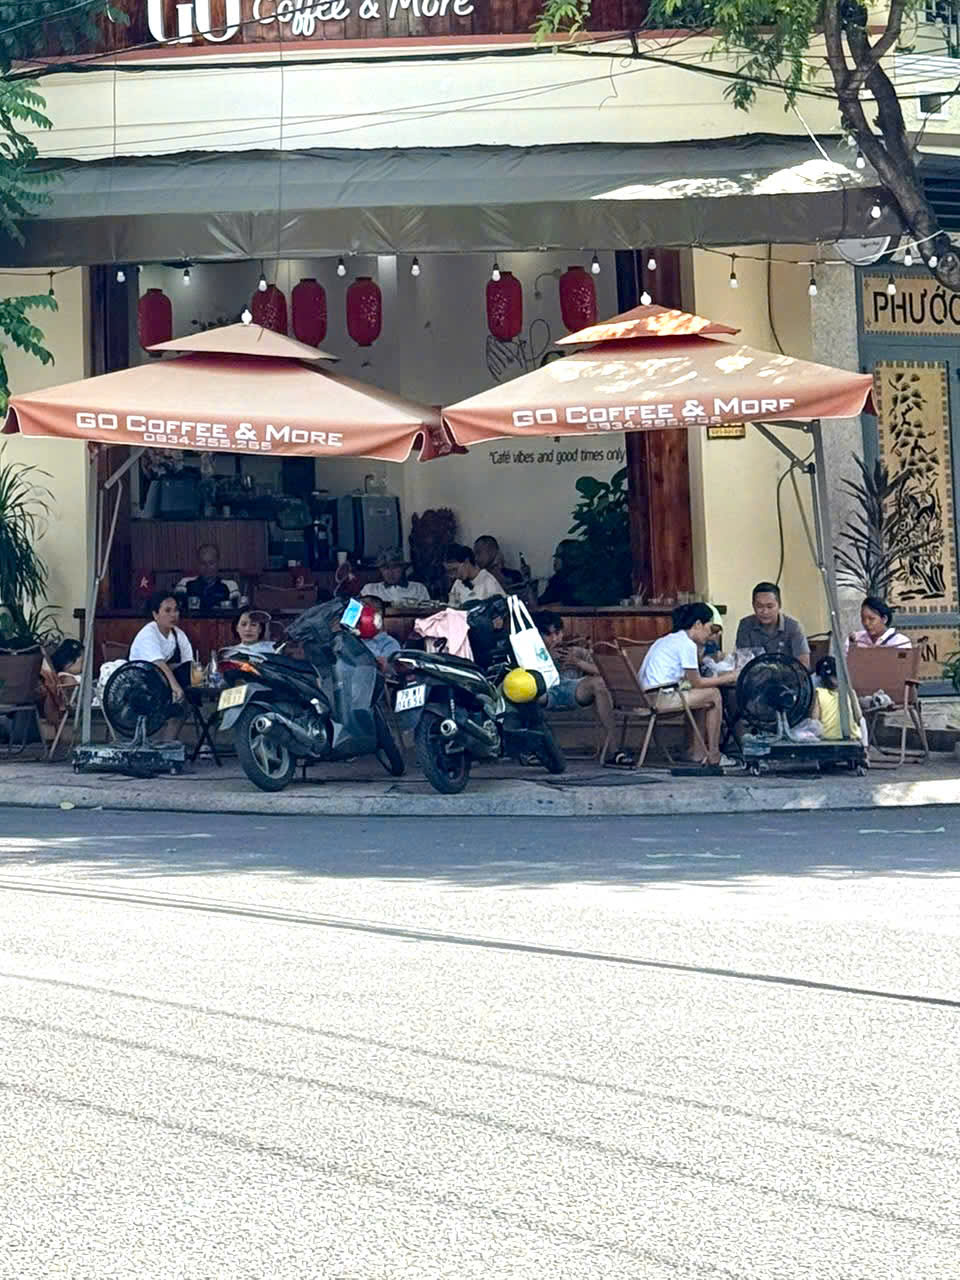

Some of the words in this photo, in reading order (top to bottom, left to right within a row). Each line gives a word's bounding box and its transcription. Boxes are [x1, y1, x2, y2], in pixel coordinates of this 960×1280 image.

[512, 407, 558, 428] GO
[565, 403, 674, 424] COFFEE
[681, 399, 706, 417] &
[76, 411, 118, 430] GO
[126, 415, 228, 439] COFFEE
[235, 422, 257, 440] &
[265, 423, 344, 447] MORE
[537, 449, 555, 464] and
[556, 448, 579, 466] good
